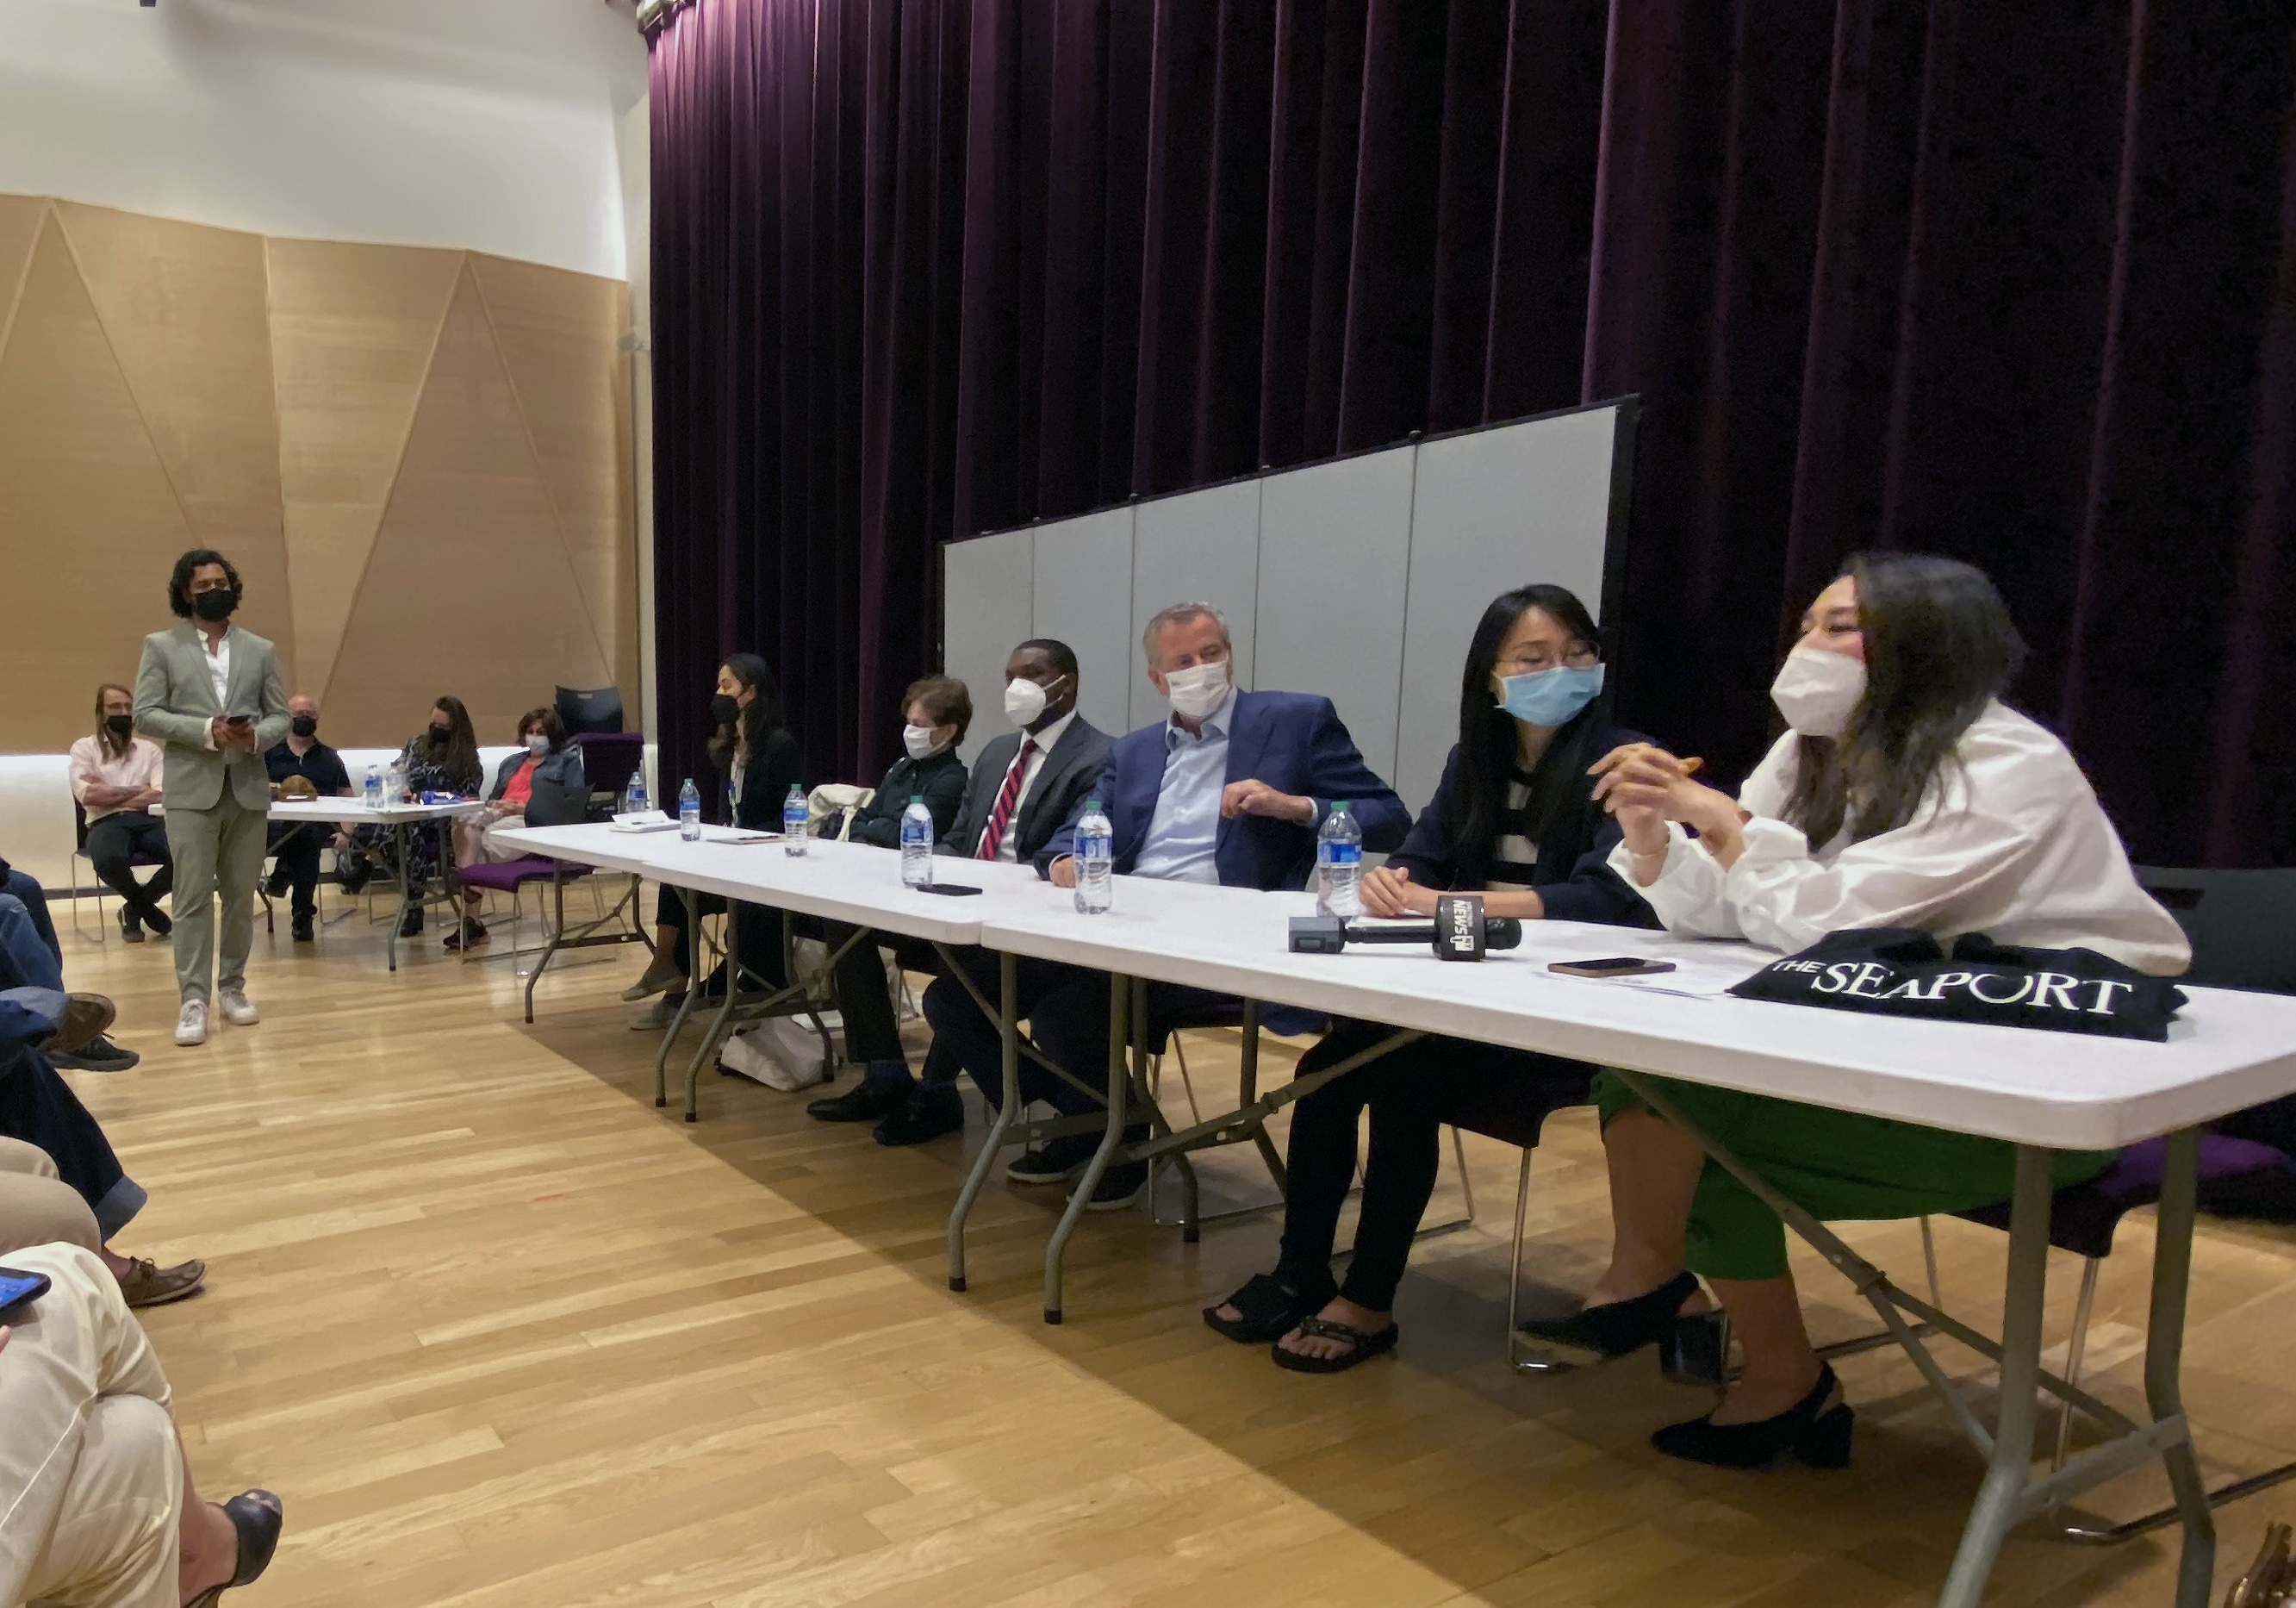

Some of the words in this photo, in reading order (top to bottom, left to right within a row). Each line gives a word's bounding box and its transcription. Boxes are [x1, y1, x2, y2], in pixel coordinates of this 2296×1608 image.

[1453, 900, 1468, 935] NEWS
[1772, 960, 1826, 974] THE
[1810, 962, 2133, 1015] SEAPORT
